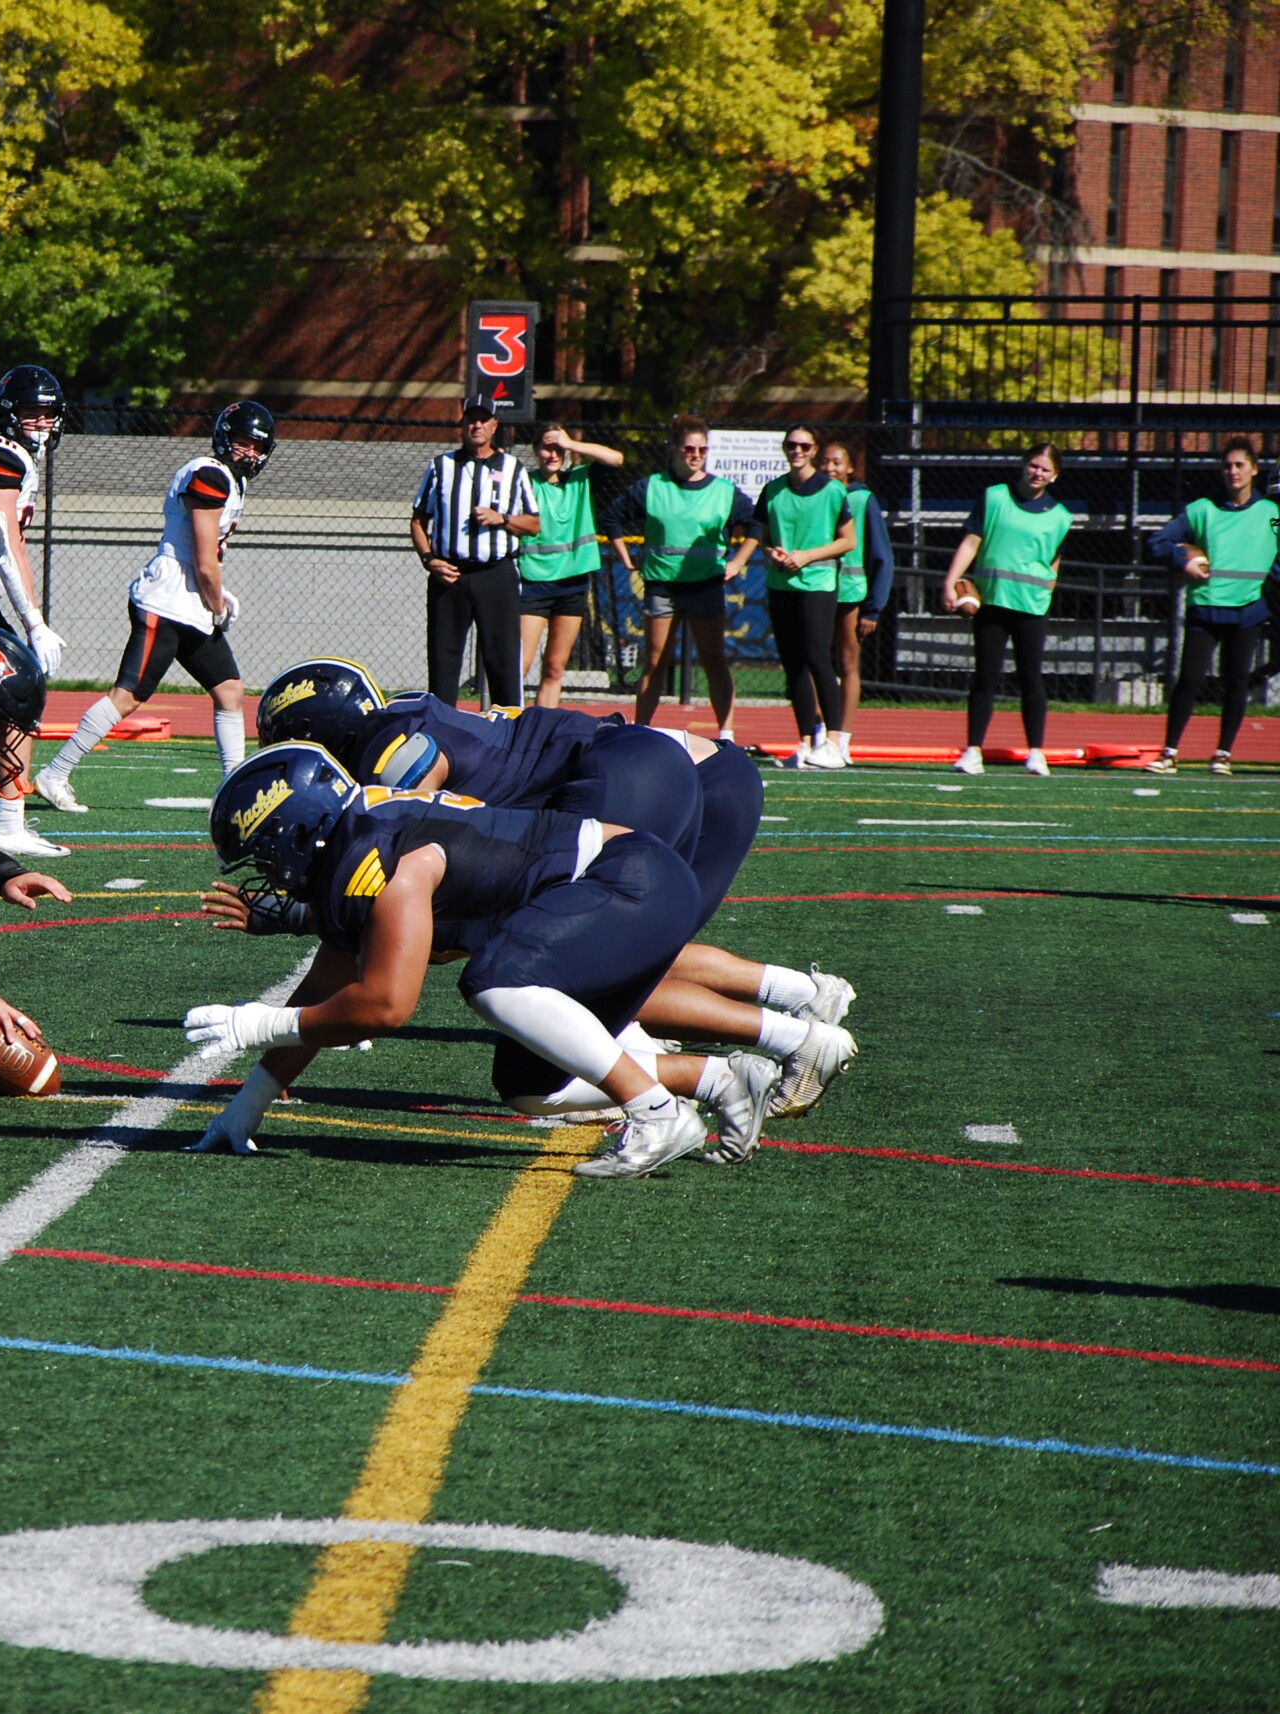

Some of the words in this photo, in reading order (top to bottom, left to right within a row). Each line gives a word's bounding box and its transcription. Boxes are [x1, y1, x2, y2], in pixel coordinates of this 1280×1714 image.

[477, 314, 528, 377] 3
[714, 459, 789, 472] AUTHORIZE
[755, 474, 778, 485] ON
[230, 778, 295, 841] Jackets
